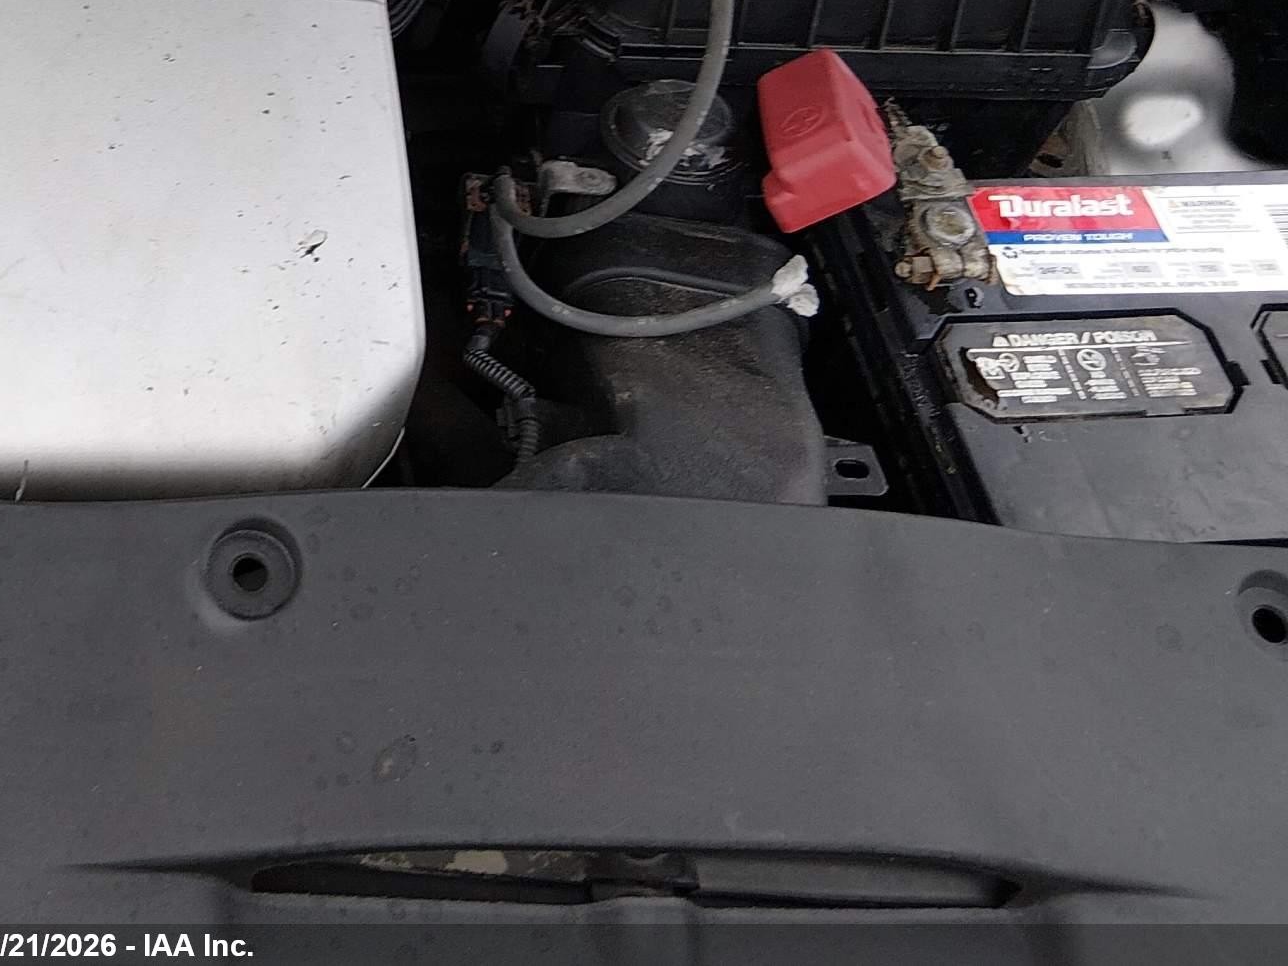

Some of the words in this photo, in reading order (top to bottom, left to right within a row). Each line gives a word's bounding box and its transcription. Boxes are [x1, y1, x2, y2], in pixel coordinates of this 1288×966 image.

[988, 194, 1133, 217] Duralast
[1023, 233, 1082, 242] PROVEN
[1083, 233, 1134, 242] TOUGH
[1008, 334, 1079, 347] DANGER
[1094, 330, 1157, 344] POISON
